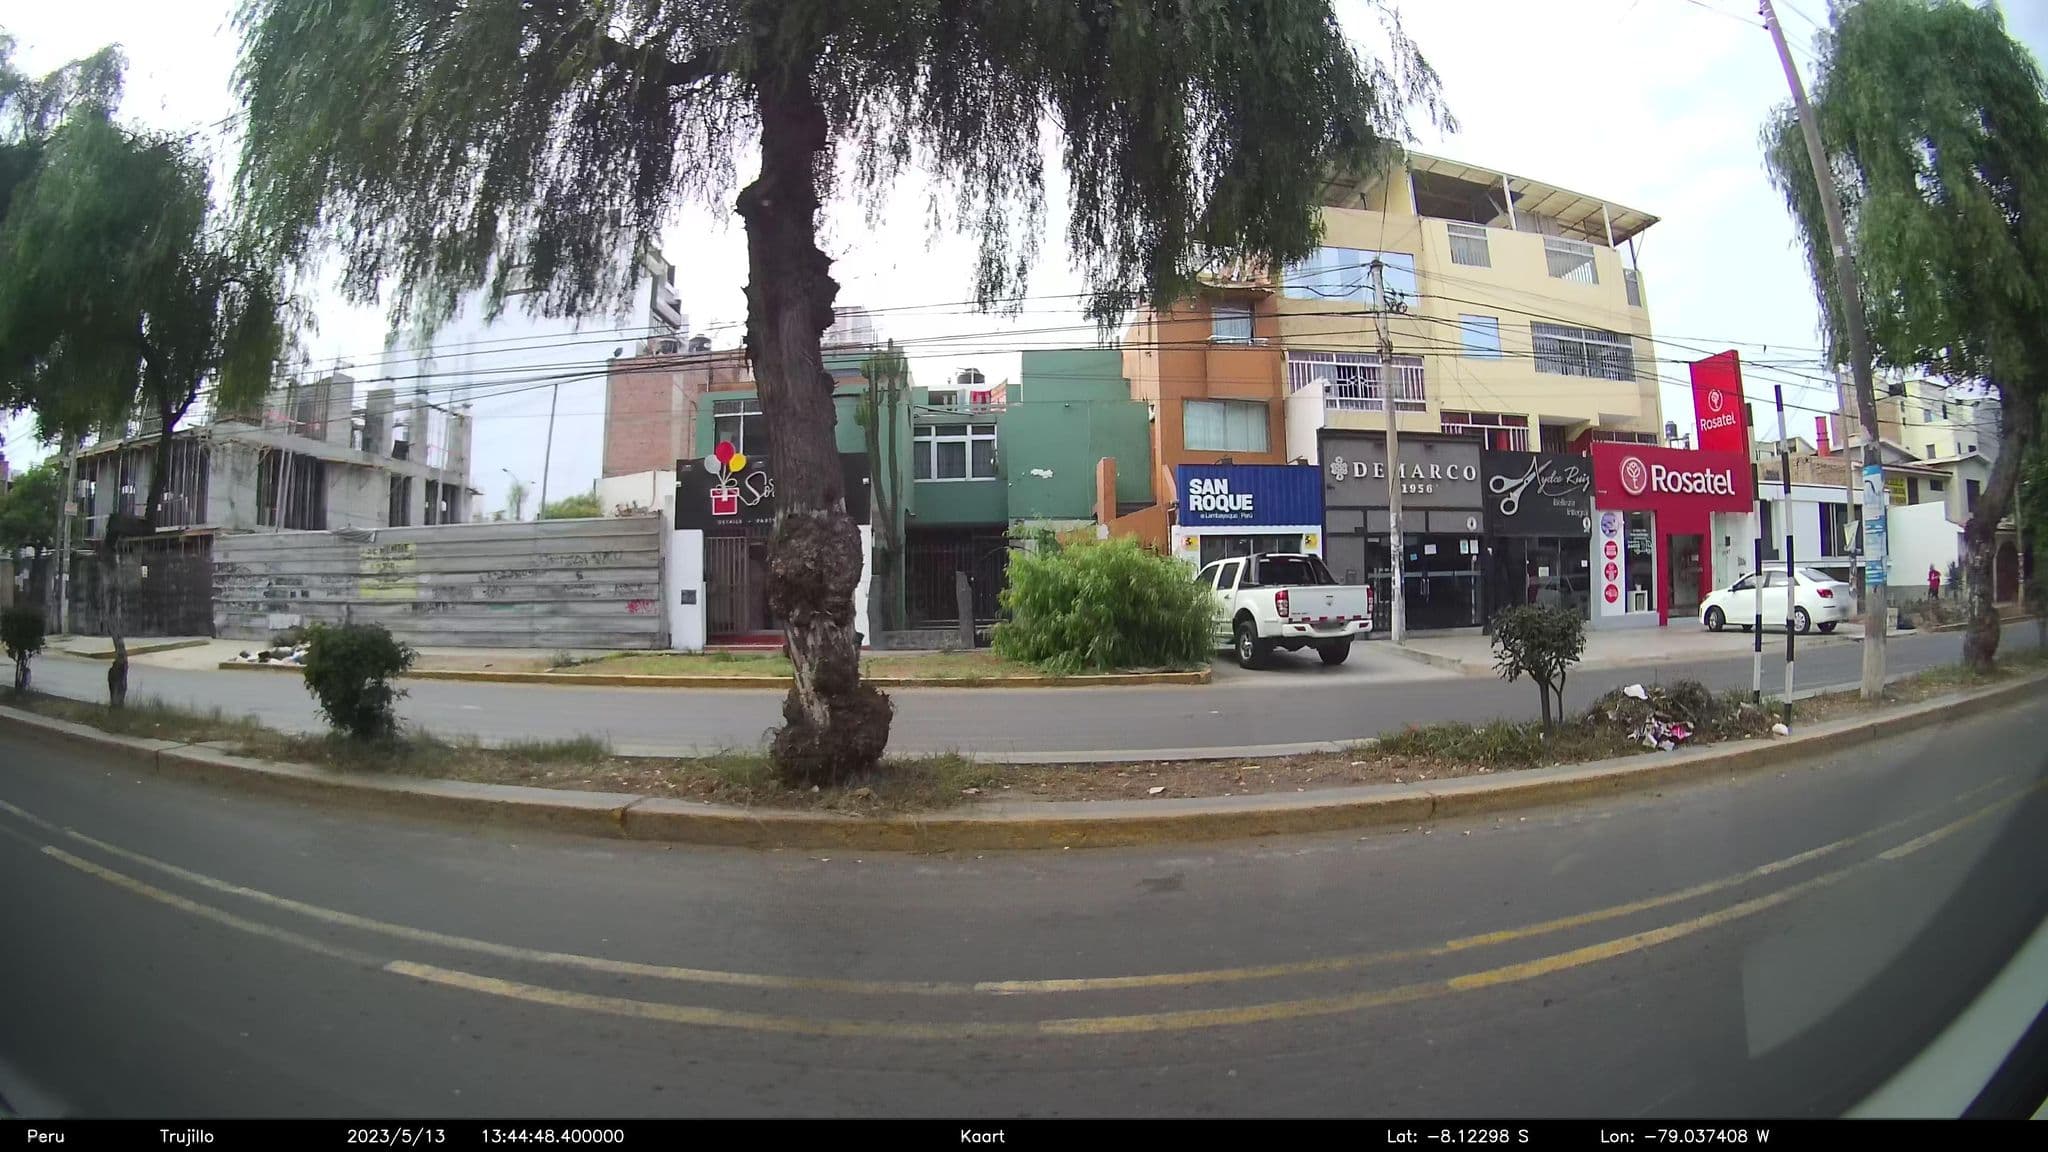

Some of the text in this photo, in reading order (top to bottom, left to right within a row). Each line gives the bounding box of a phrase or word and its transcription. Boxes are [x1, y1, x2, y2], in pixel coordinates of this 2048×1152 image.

[1700, 411, 1737, 432] Rosatel
[1189, 478, 1229, 495] SAN
[1402, 483, 1433, 494] 1956
[1564, 466, 1590, 492] Ruiz
[1651, 464, 1736, 496] Rosatel
[1189, 494, 1254, 513] ROQUE
